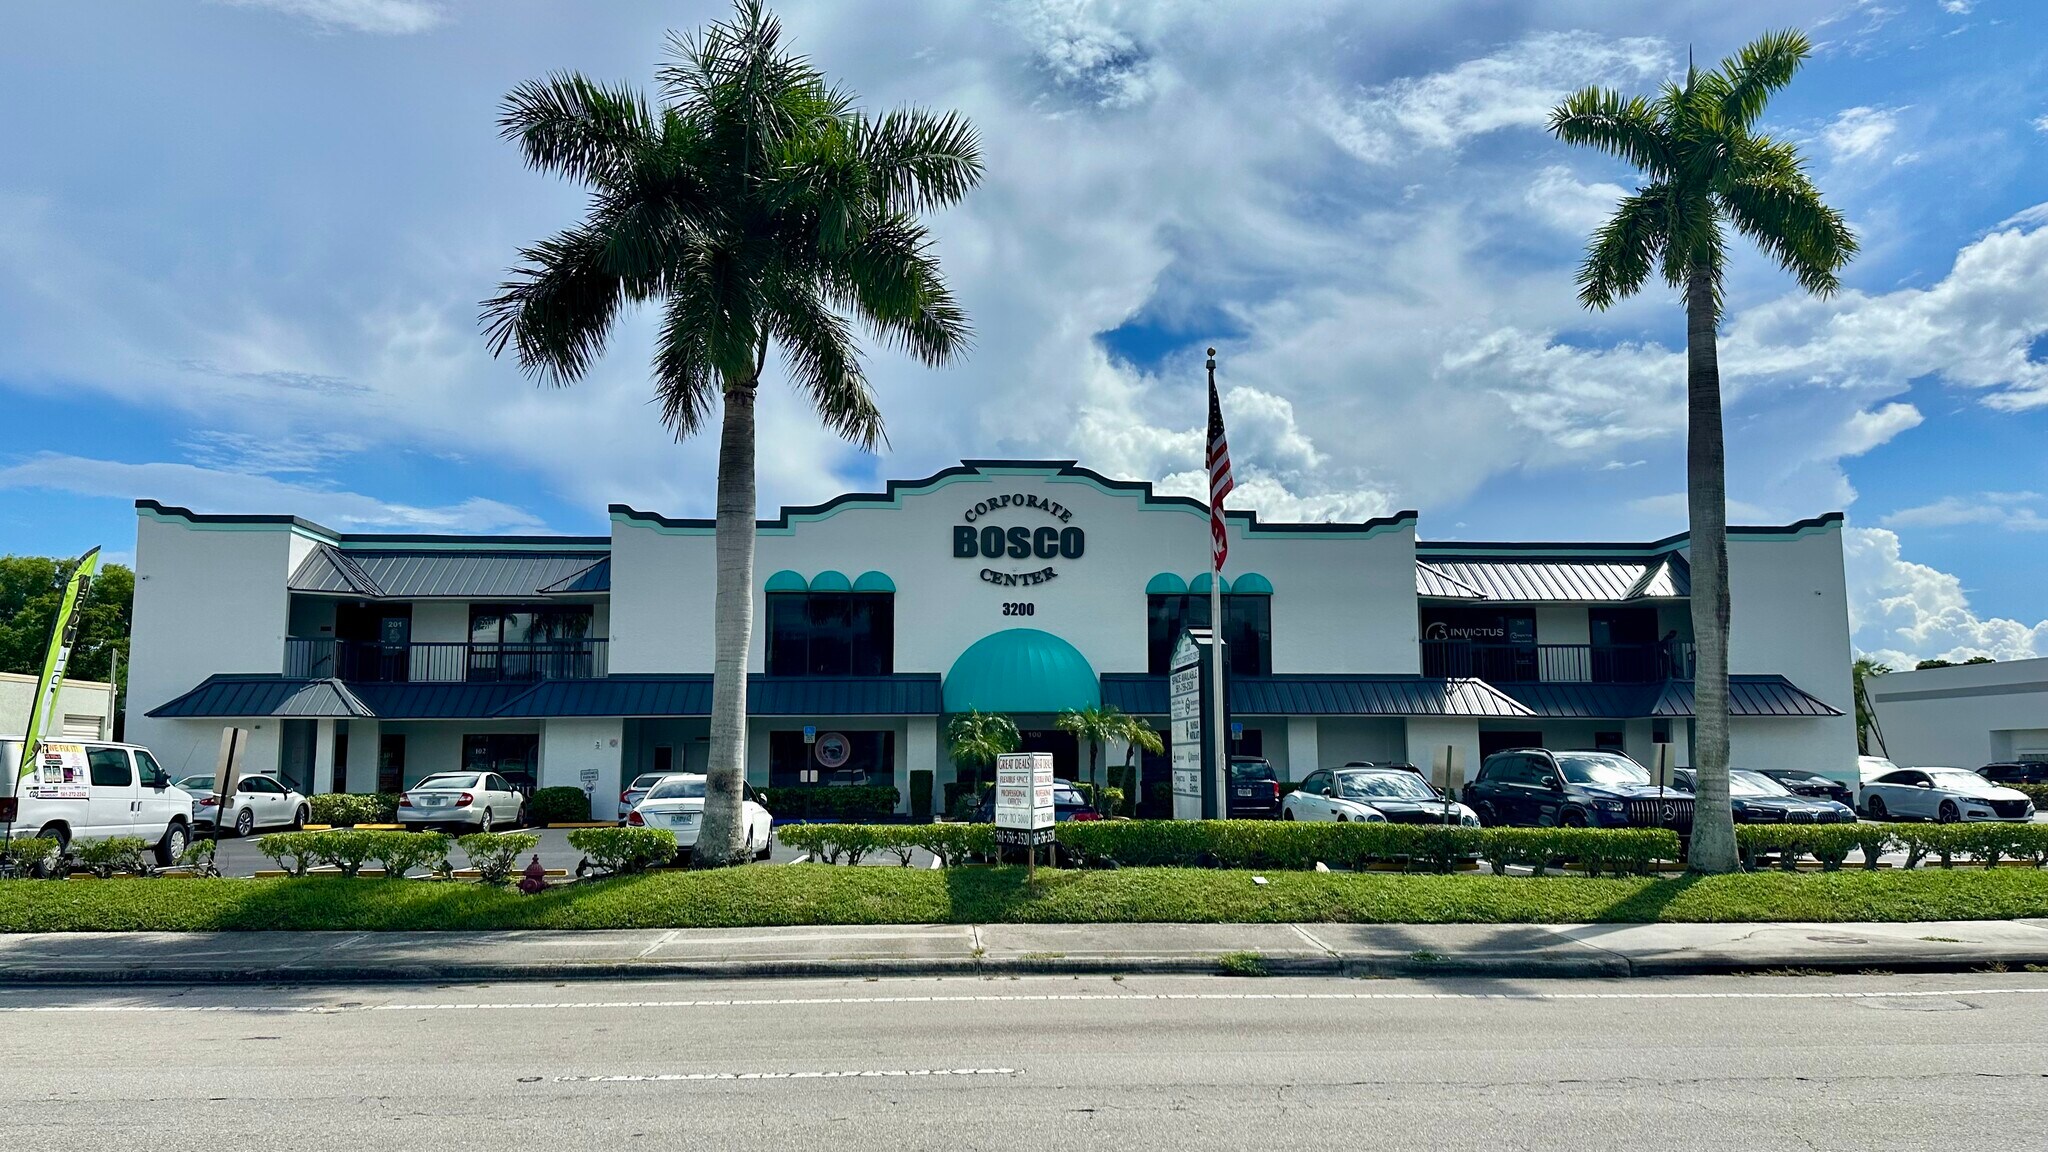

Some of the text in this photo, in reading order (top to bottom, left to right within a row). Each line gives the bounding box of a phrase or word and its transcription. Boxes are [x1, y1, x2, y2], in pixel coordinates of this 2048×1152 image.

[964, 493, 1073, 524] CORPORATE
[953, 525, 1085, 559] BOSCO
[980, 566, 1058, 587] CENTER
[1002, 602, 1035, 616] 3200
[1450, 628, 1504, 639] INVICTUS
[1171, 669, 1198, 685] SPACE AVAILABLE
[999, 759, 1030, 769] GREAT DEALS
